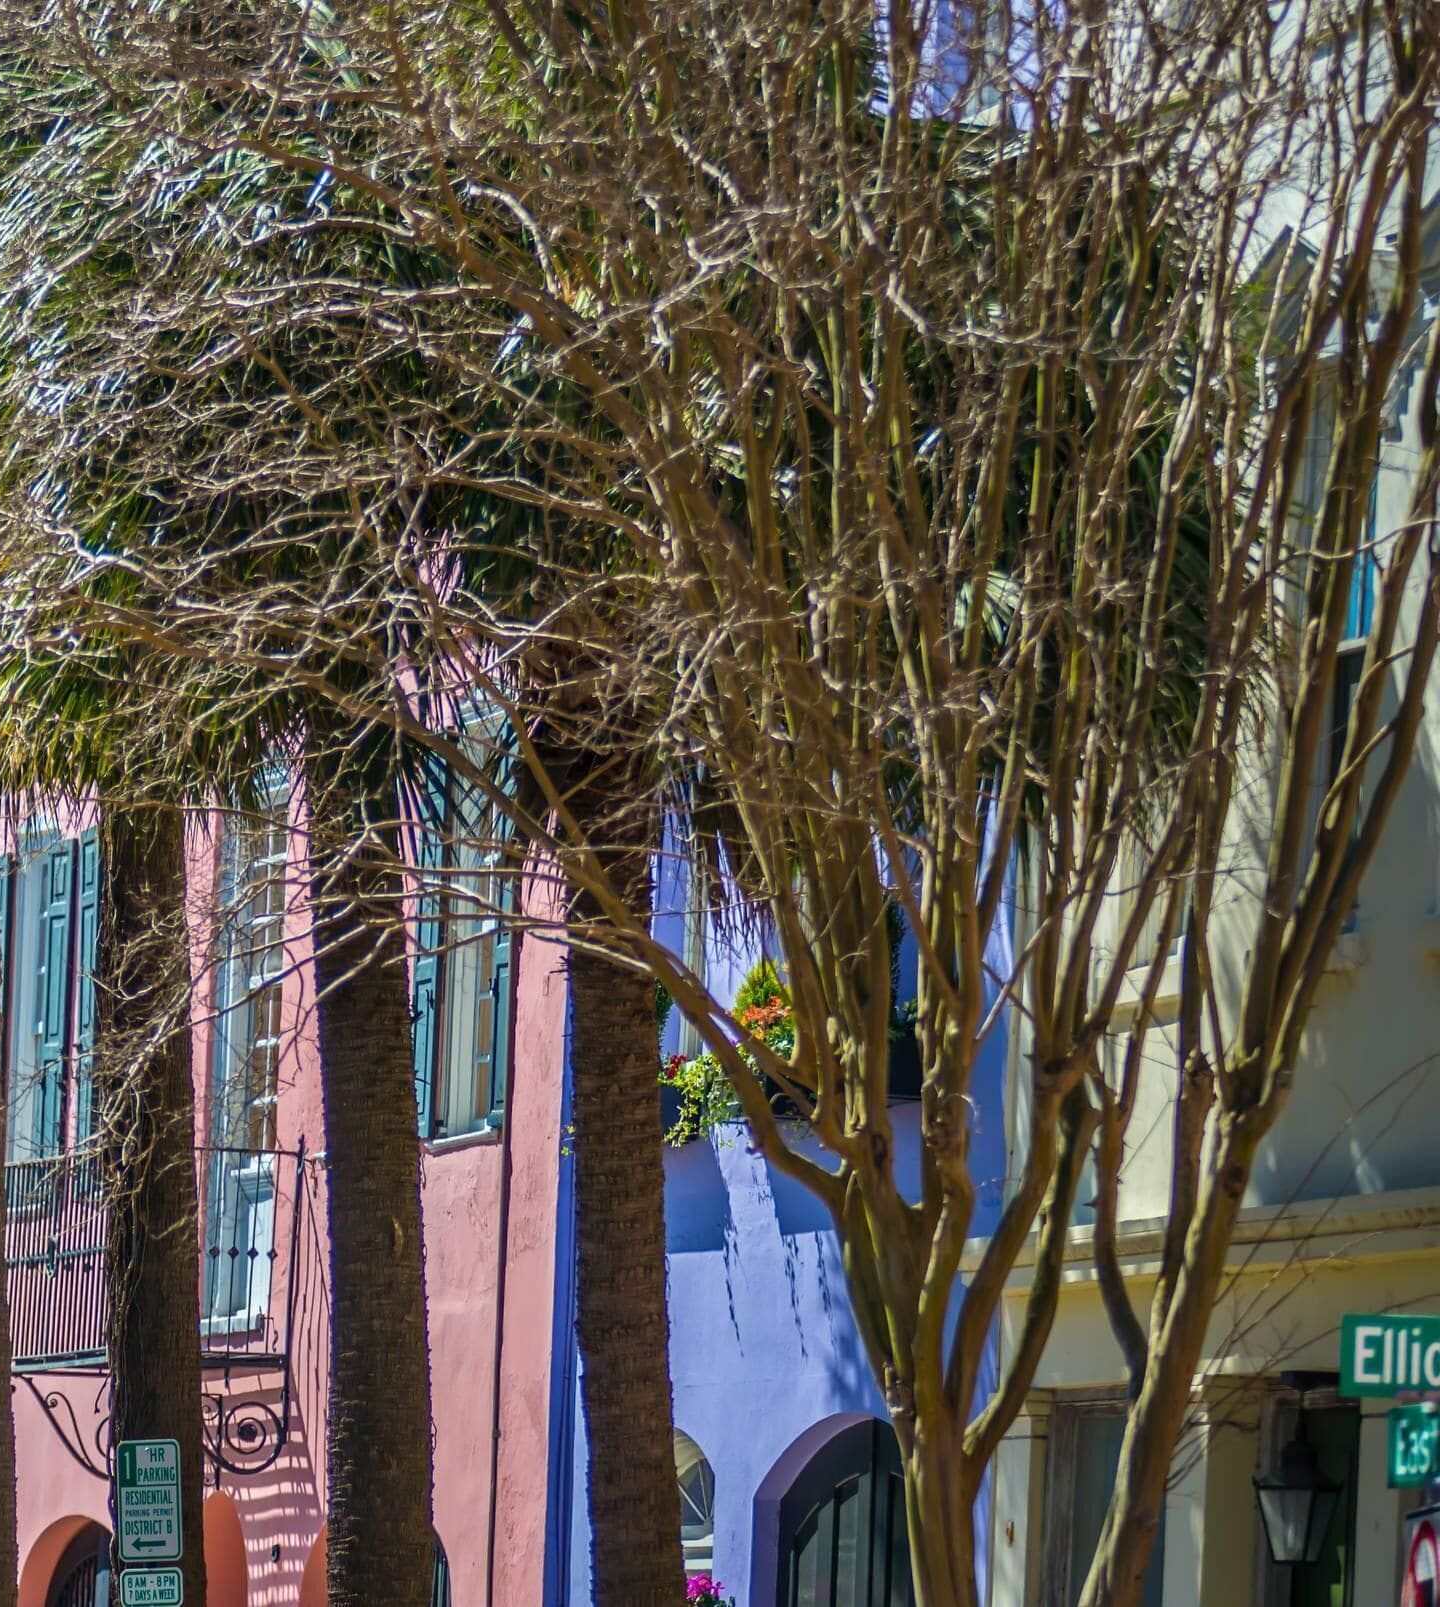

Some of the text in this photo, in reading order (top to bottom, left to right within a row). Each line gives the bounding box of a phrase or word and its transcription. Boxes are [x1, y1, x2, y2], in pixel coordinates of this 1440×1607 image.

[124, 1447, 165, 1480] 1 HR
[137, 1467, 176, 1482] PARKING
[125, 1490, 174, 1505] RESIDENTIAL
[125, 1507, 174, 1517] PARKING PERMIT
[125, 1520, 173, 1536] DISTRICT B
[127, 1577, 133, 1588] 8
[134, 1576, 147, 1588] AM
[156, 1575, 162, 1587] 8
[163, 1575, 175, 1586] PM
[128, 1589, 175, 1600] 7 DAYS A WEEK
